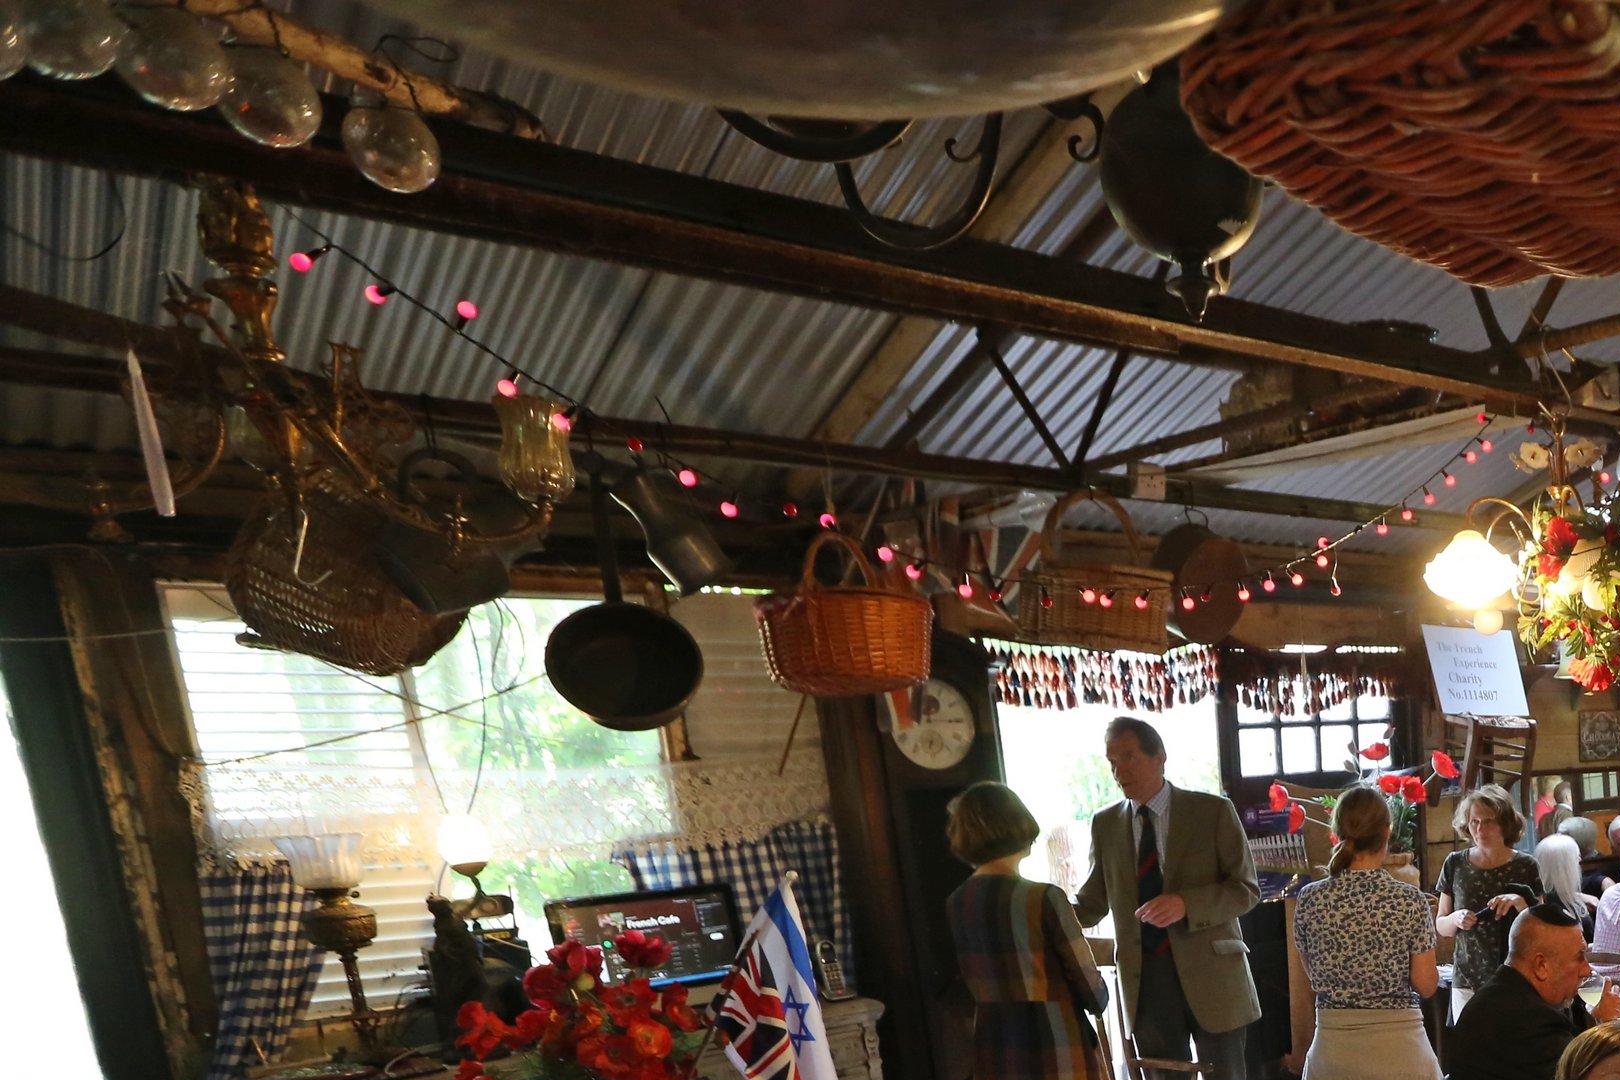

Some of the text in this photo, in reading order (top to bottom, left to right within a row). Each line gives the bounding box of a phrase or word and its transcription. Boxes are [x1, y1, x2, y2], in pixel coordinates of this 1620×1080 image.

[1438, 642, 1483, 654] The Trench
[1453, 658, 1497, 670] Experience
[1449, 671, 1482, 687] Charity
[1448, 688, 1499, 702] No.1114807
[626, 914, 680, 929] French Cafe
